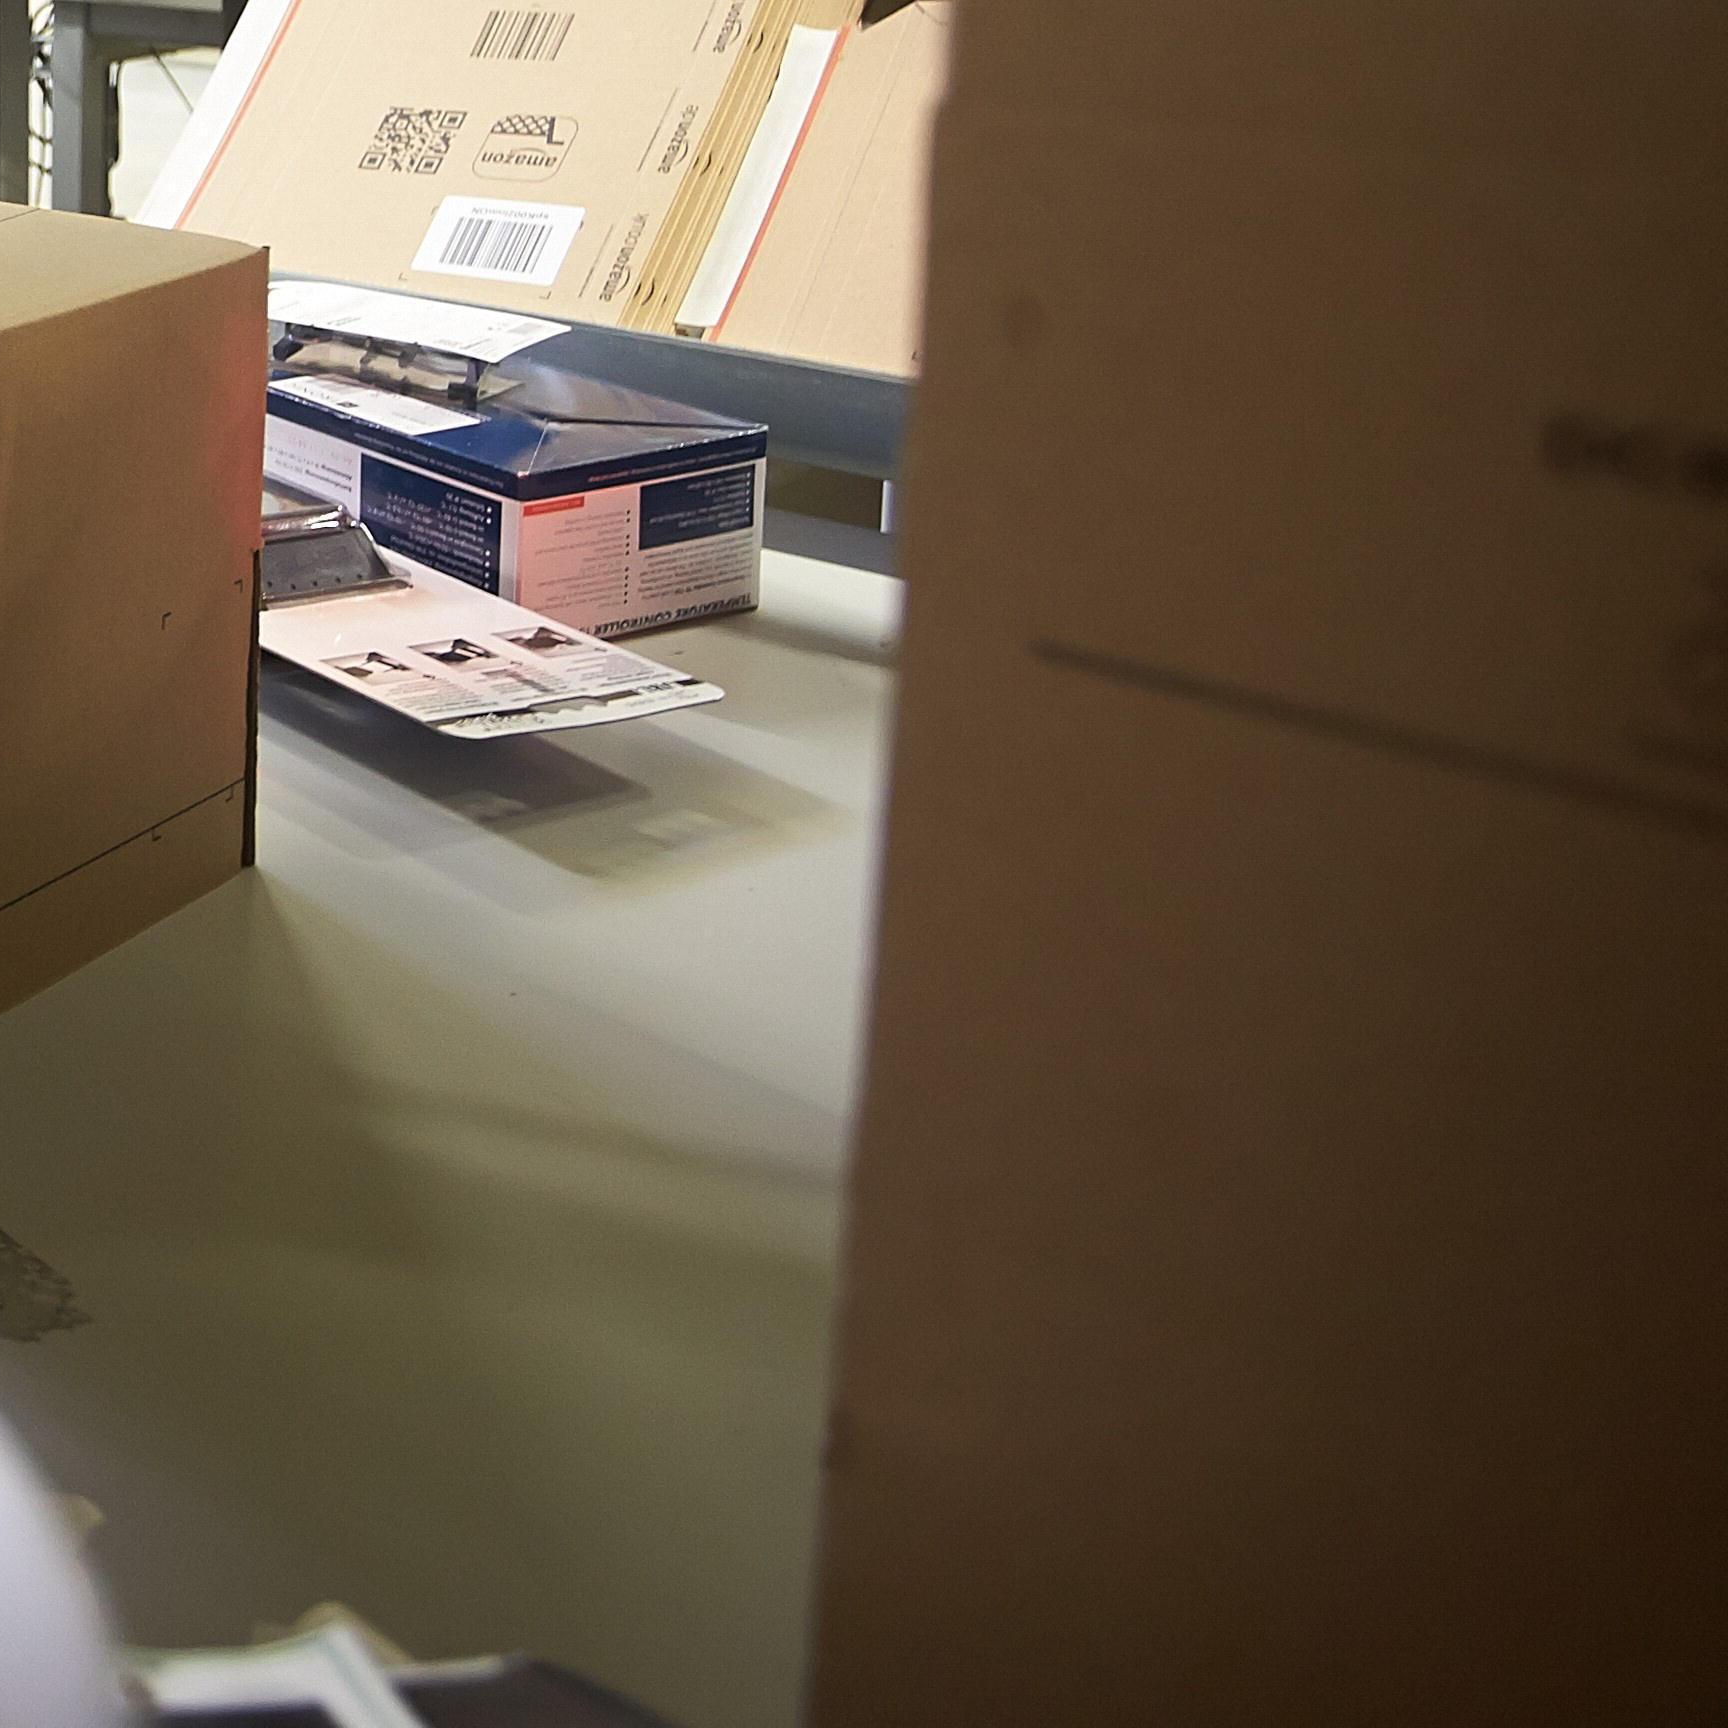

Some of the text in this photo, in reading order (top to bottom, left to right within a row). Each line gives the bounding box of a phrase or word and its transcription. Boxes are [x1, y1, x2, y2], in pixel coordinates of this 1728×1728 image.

[481, 150, 558, 168] amazon
[675, 592, 752, 618] TEMPERATURE
[595, 610, 672, 635] CONTROLLER
